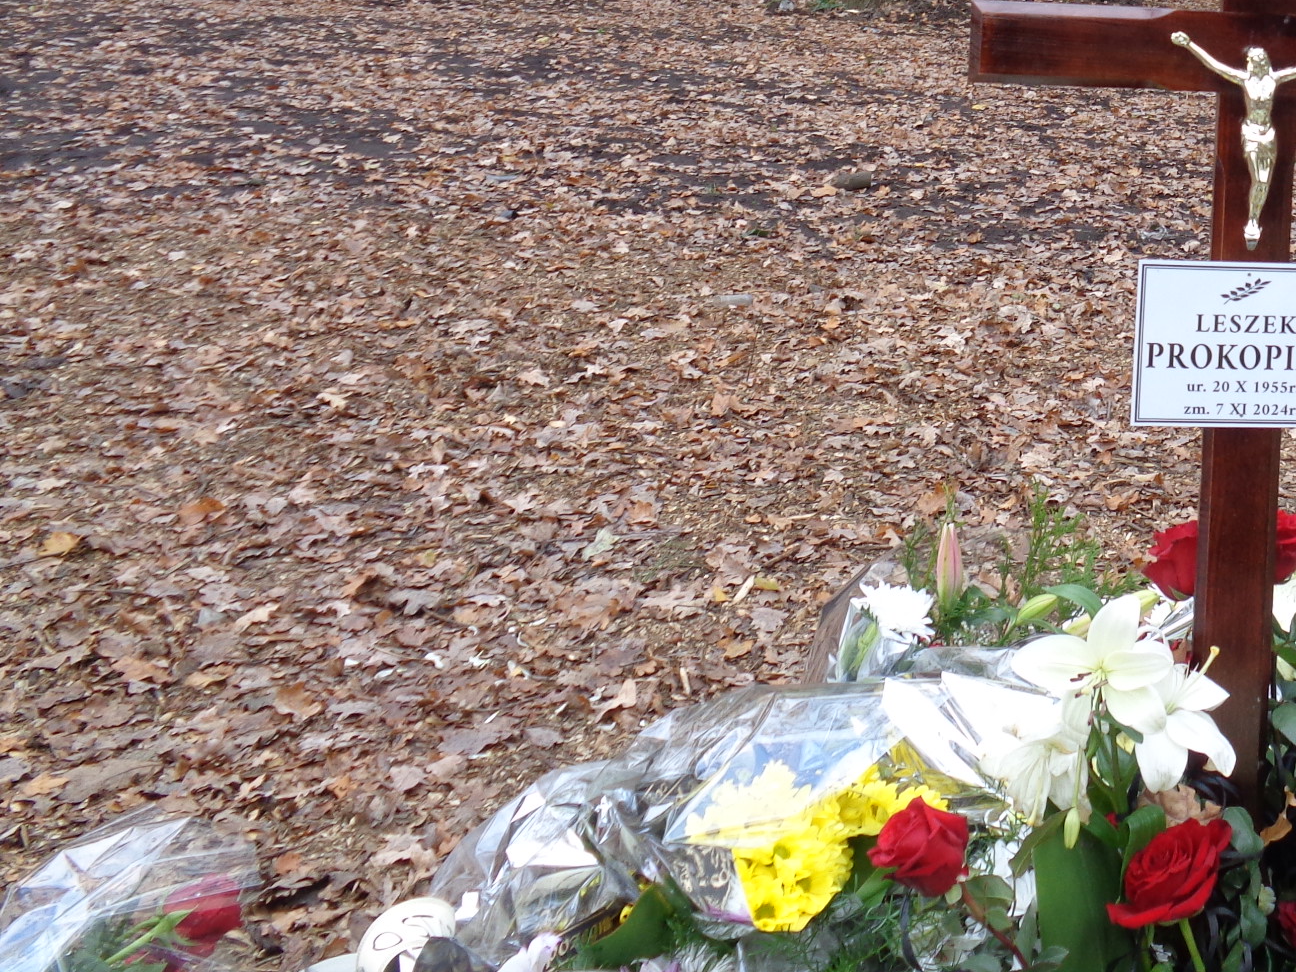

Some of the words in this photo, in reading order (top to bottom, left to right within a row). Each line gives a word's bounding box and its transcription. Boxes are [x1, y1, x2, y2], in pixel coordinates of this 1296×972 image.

[1186, 382, 1207, 393] ur.
[1212, 380, 1231, 393] 20
[1235, 380, 1248, 393] X
[1183, 405, 1210, 416] zm.
[1216, 403, 1224, 415] 7
[1229, 403, 1247, 416] XI
